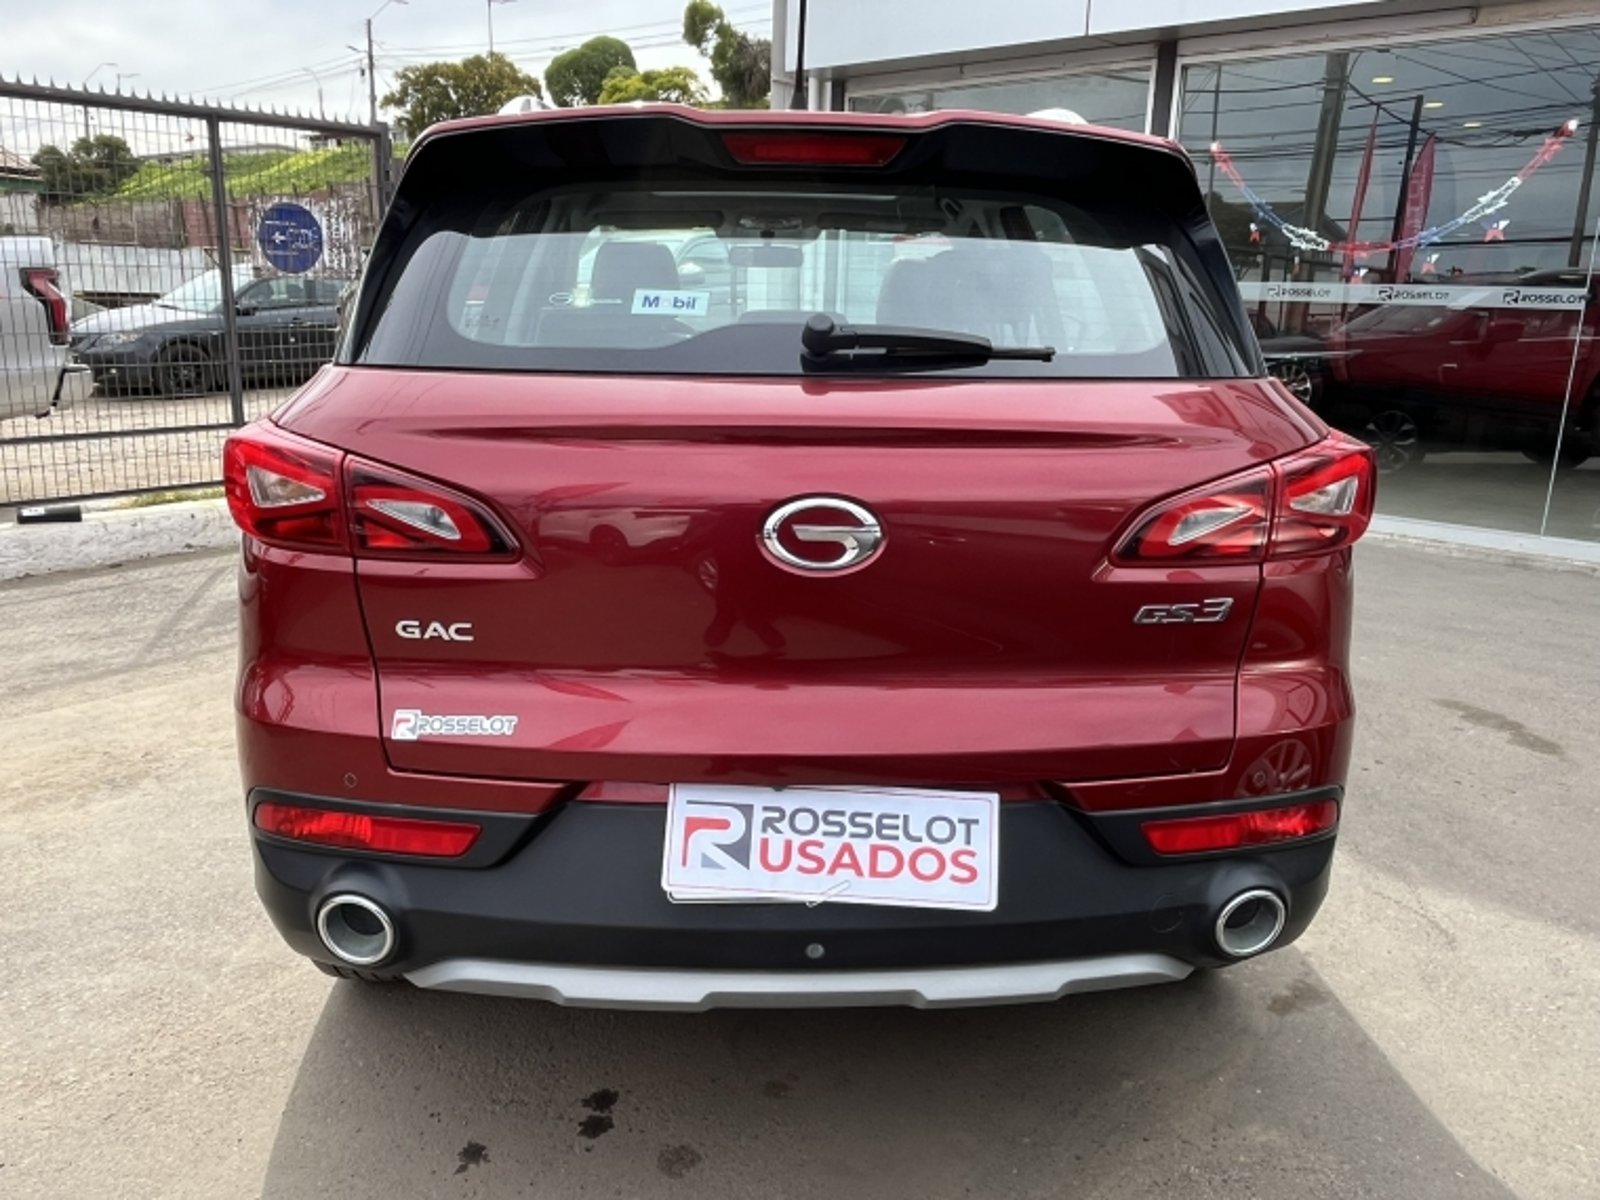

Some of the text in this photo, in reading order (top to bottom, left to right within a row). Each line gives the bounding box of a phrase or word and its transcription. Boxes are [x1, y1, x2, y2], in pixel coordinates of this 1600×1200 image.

[1133, 597, 1234, 623] GS3
[395, 620, 474, 641] GAC
[418, 717, 517, 733] ROSSELOT
[761, 806, 980, 845] ROSSELOT
[759, 837, 979, 885] USADOS
